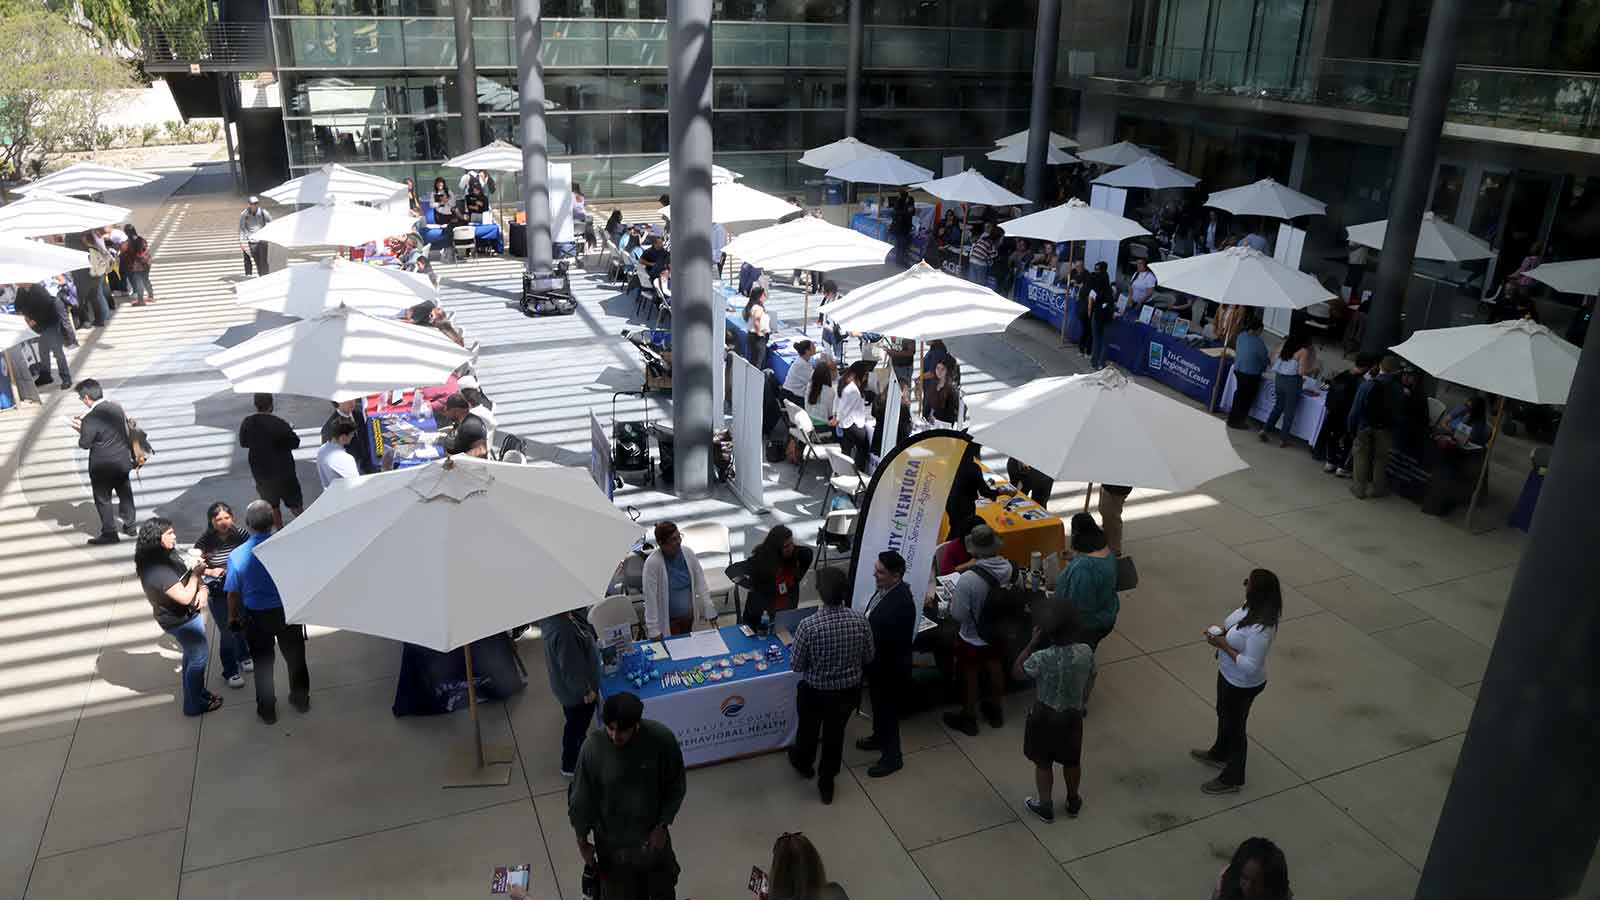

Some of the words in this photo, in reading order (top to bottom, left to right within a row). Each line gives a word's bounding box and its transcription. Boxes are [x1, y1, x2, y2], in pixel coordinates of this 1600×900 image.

[1163, 357, 1188, 377] Regional
[1189, 370, 1210, 385] Center
[895, 460, 921, 518] VENTURA
[918, 472, 936, 504] Agency
[748, 720, 786, 733] HEALTH
